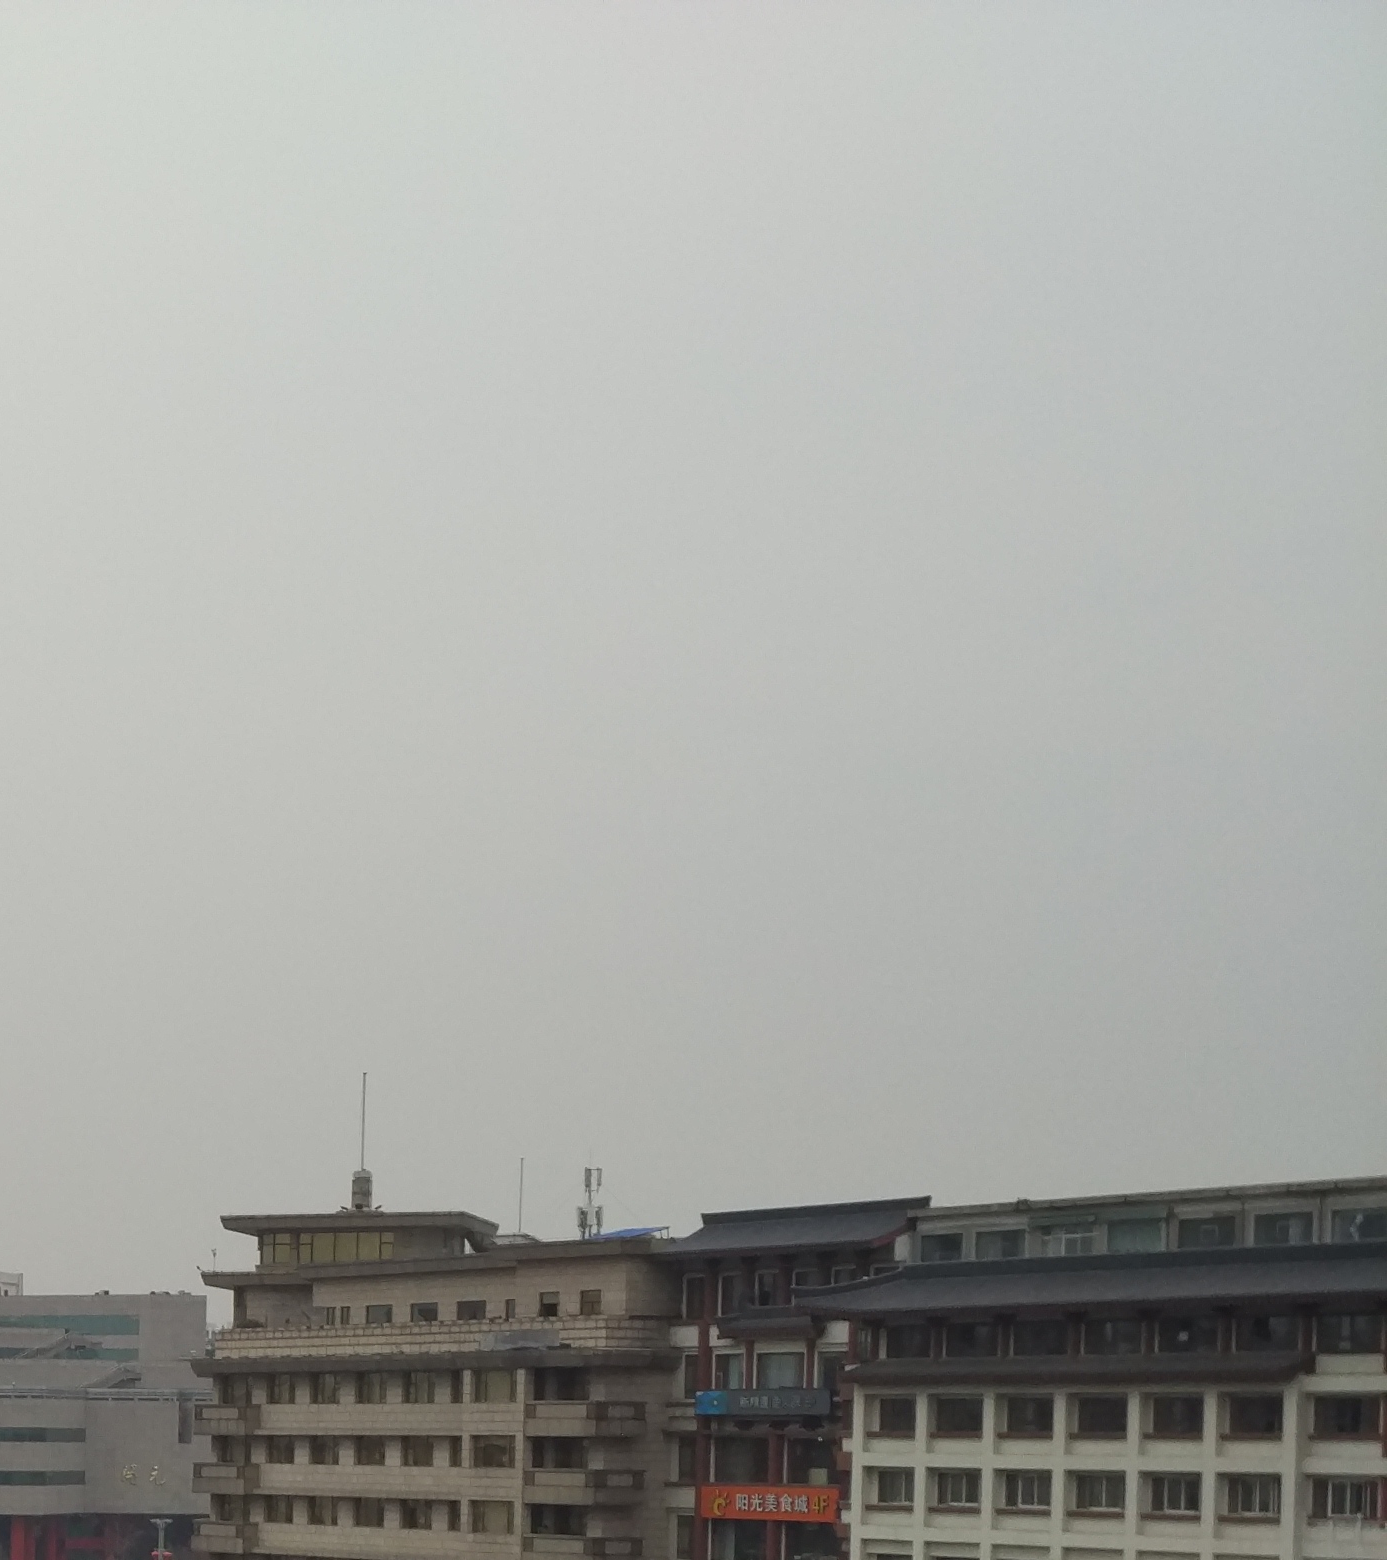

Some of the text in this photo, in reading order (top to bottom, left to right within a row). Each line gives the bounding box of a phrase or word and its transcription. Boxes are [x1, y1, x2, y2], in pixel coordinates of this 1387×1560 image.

[735, 1493, 830, 1515] 阳光美食城 4F
